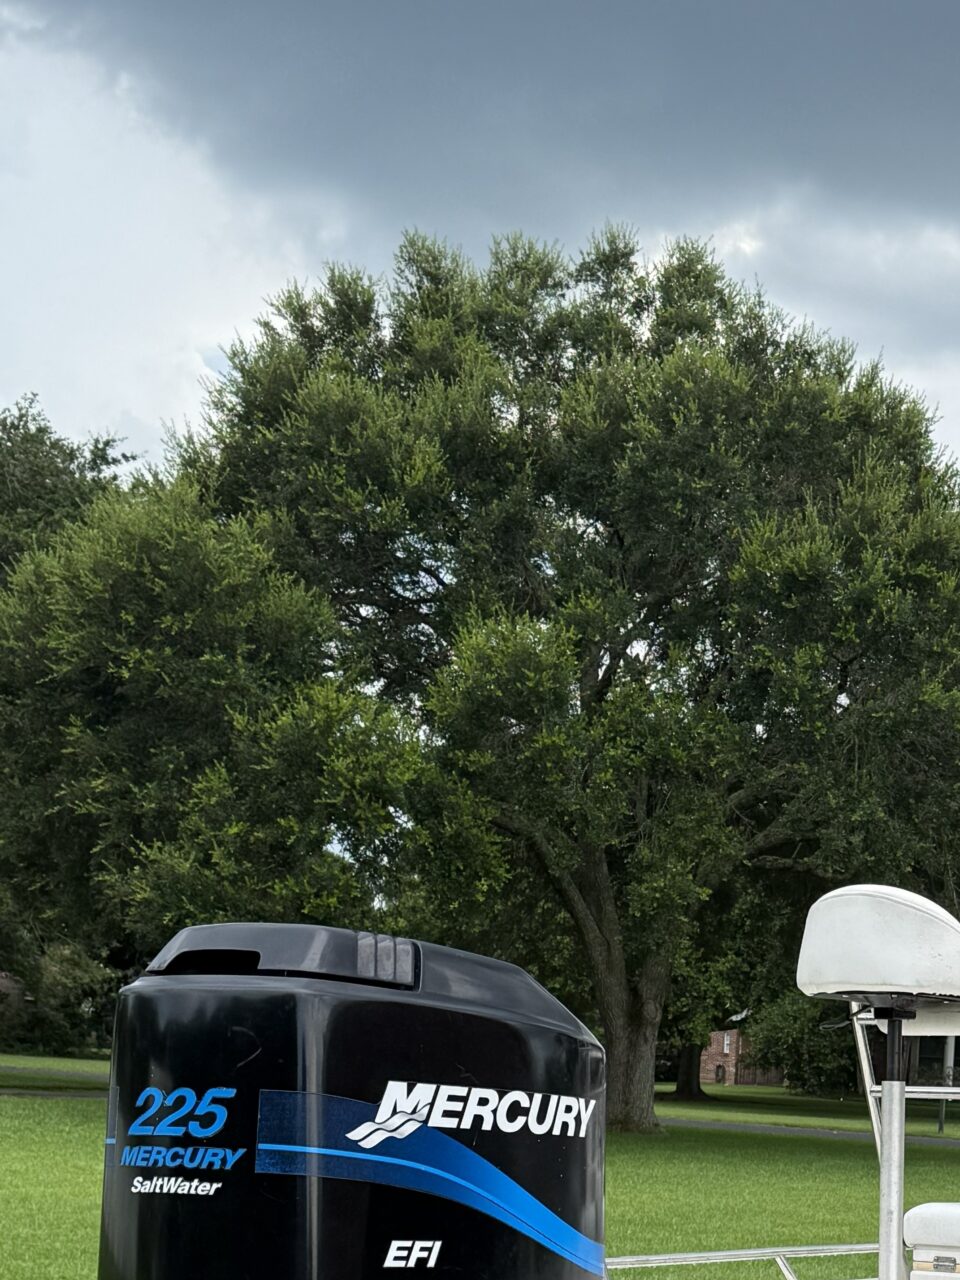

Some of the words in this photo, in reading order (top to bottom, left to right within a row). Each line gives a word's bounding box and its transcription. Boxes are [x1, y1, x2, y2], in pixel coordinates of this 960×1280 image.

[127, 1086, 237, 1138] 225
[374, 1080, 597, 1138] MERCURY
[120, 1145, 247, 1170] MERCURY
[130, 1176, 222, 1195] SaltWater
[383, 1240, 442, 1268] EFI
